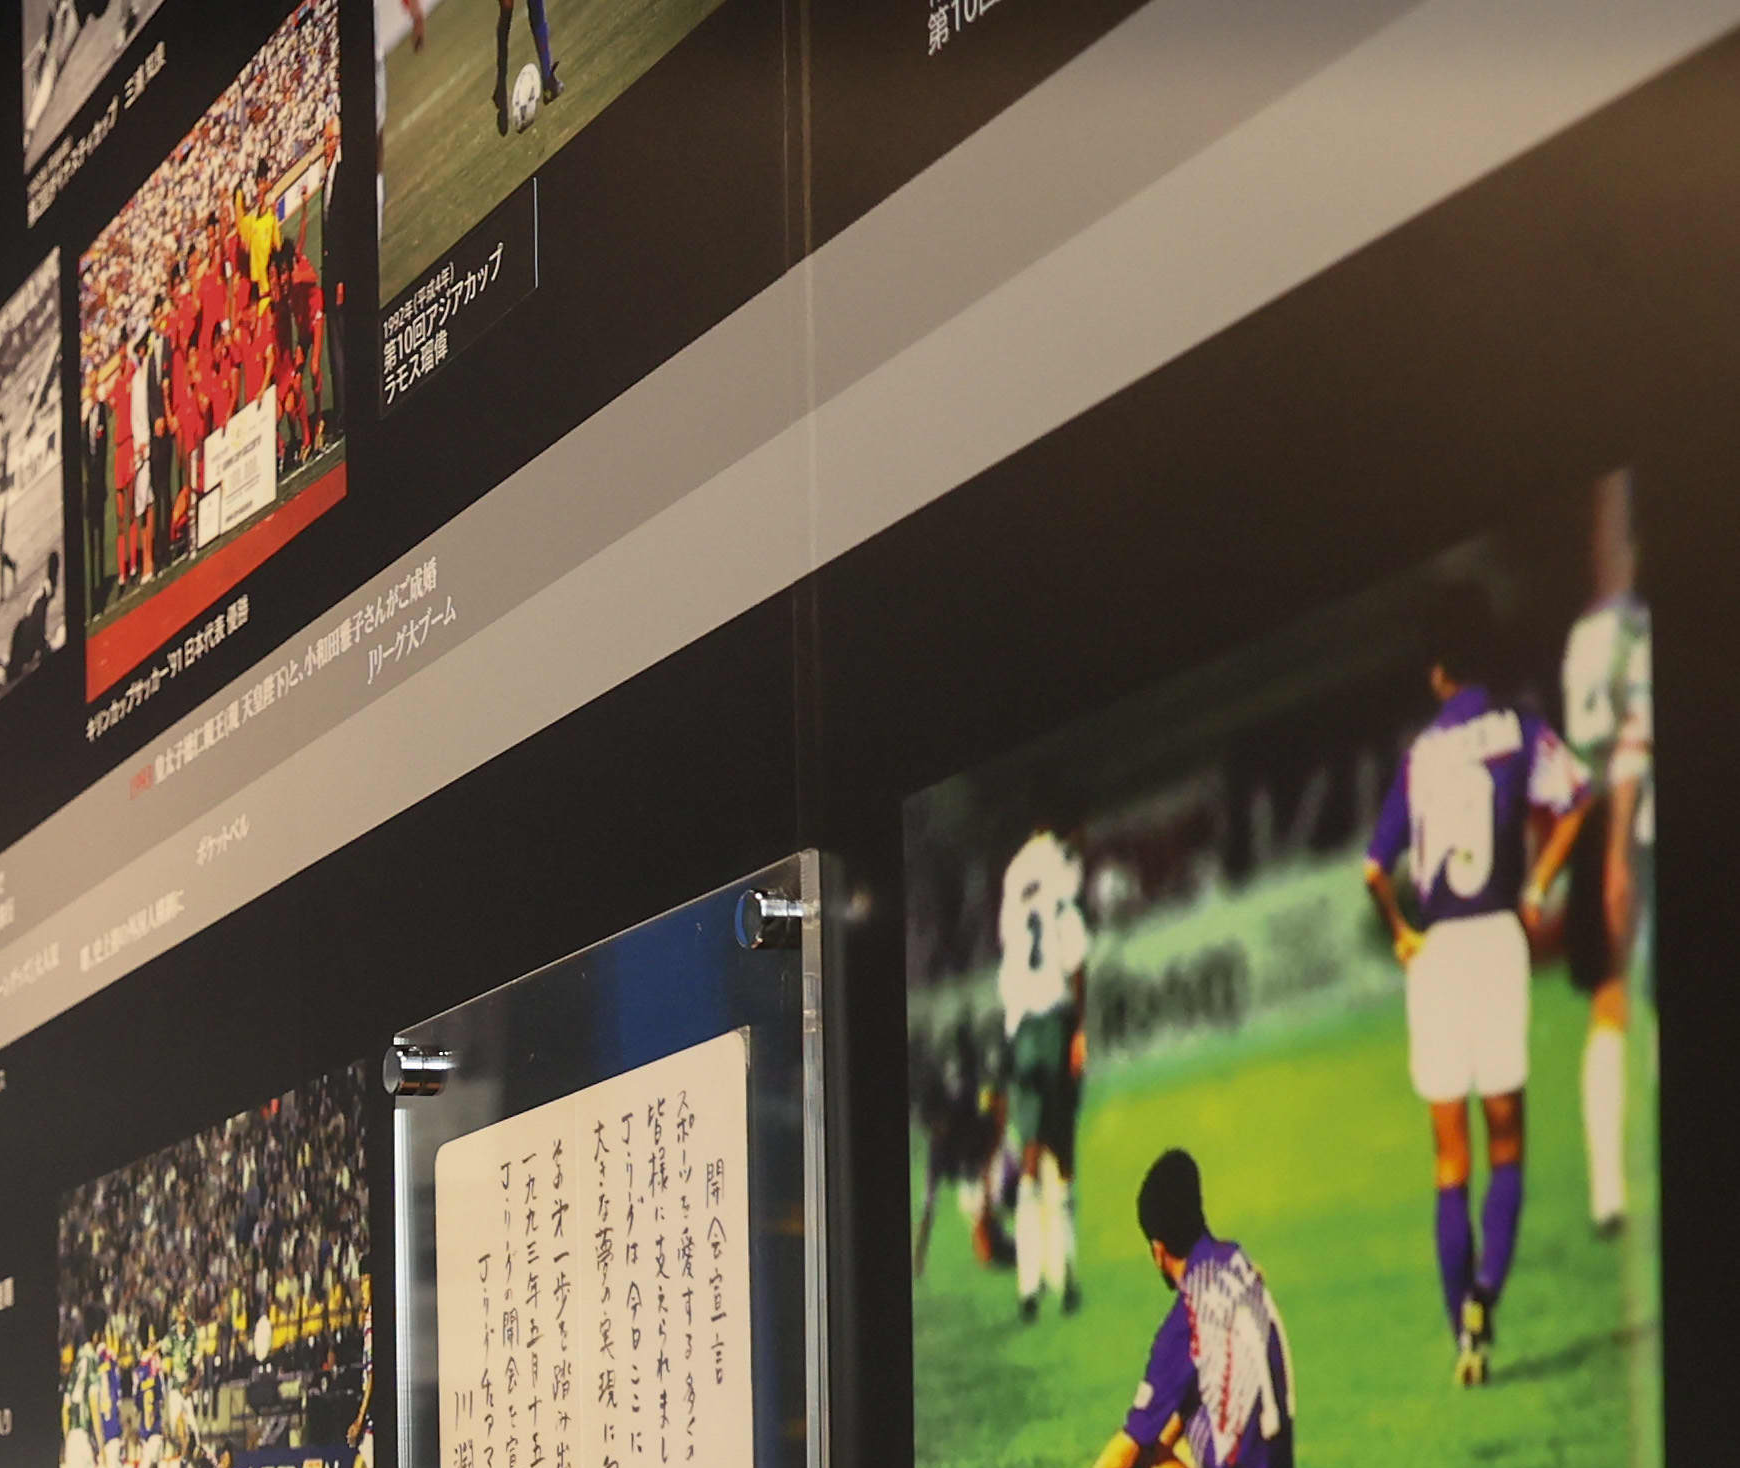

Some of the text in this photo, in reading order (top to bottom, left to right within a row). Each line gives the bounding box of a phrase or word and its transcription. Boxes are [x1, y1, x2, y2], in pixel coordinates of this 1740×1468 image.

[382, 243, 505, 374] 第10回アジアカップ
[383, 332, 449, 404] ラモス瑠偉
[367, 595, 457, 685] Jリーグ大ブーム
[705, 1158, 727, 1385] 開会宣言
